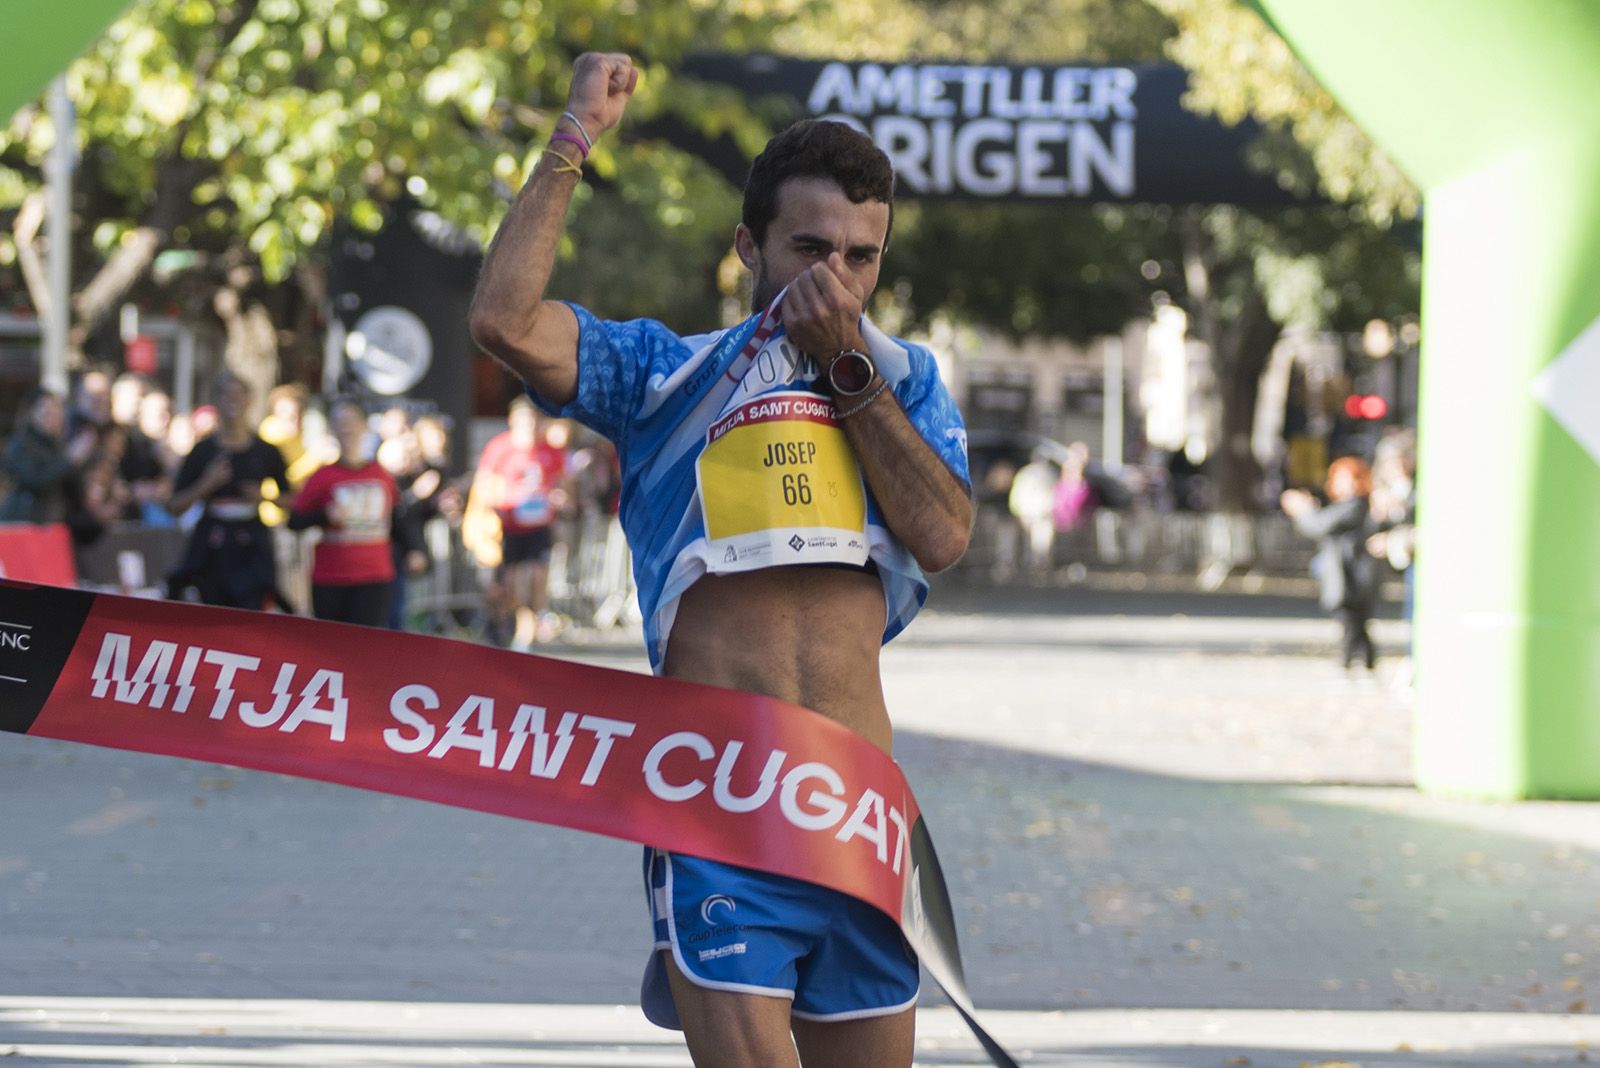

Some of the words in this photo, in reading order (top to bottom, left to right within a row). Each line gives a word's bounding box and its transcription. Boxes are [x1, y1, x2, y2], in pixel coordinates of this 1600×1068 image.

[807, 63, 1138, 120] AMETLLER
[822, 114, 1137, 196] RIGEN
[714, 412, 745, 439] MITJA
[749, 401, 791, 419] SANT
[793, 401, 829, 418] CUGAT
[764, 442, 816, 467] JOSEP
[782, 473, 812, 506] 66
[0, 630, 31, 651] NC
[91, 632, 349, 743] MITJA
[382, 684, 636, 786] SANT
[642, 732, 906, 876] CUGAT
